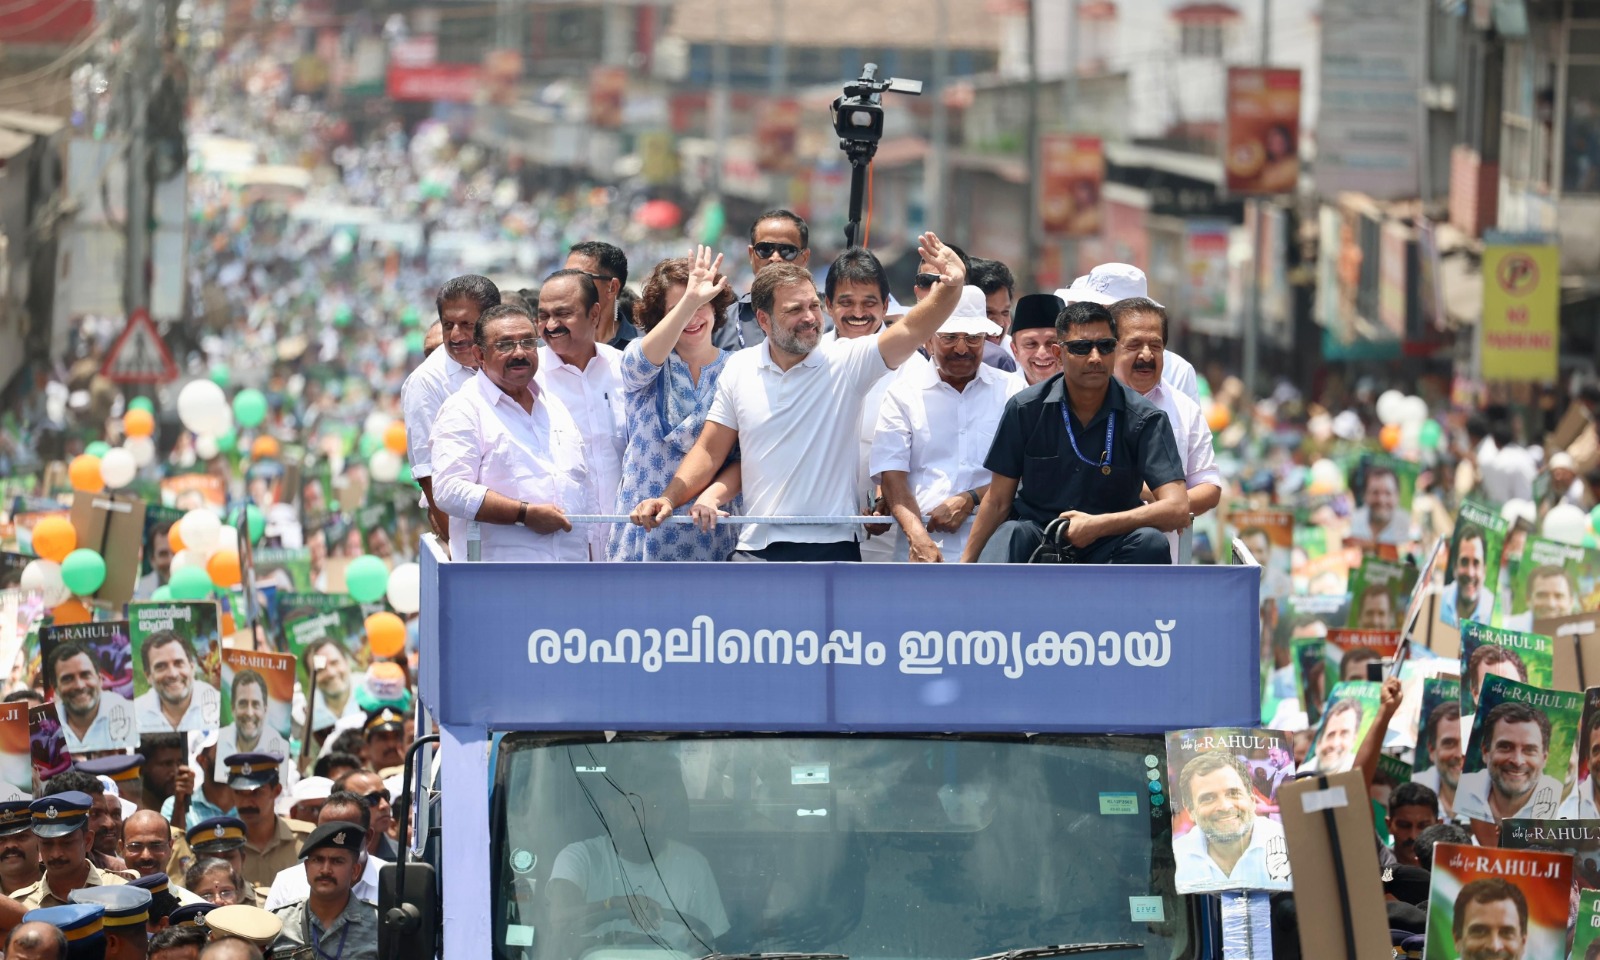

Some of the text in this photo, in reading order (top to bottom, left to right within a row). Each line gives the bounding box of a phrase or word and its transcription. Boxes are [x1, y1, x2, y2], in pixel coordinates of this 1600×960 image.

[65, 626, 109, 640] RAHUL
[111, 624, 121, 638] JI
[1486, 629, 1533, 650] RAHUL
[1533, 639, 1545, 651] JI
[528, 615, 1176, 679] രാഹുലിനൊപ്പം ഇന്ത്യക്കായ്
[239, 655, 274, 670] RAHUL
[276, 658, 287, 671] JI
[1512, 687, 1562, 709] RAHUL
[1564, 697, 1577, 710] JI
[1203, 735, 1265, 750] RAHUL
[1267, 737, 1280, 750] JI
[1512, 827, 1523, 838] vote
[1524, 829, 1534, 841] for
[1534, 827, 1594, 839] RAHUL
[1449, 853, 1560, 878] vote for RAHUL JI
